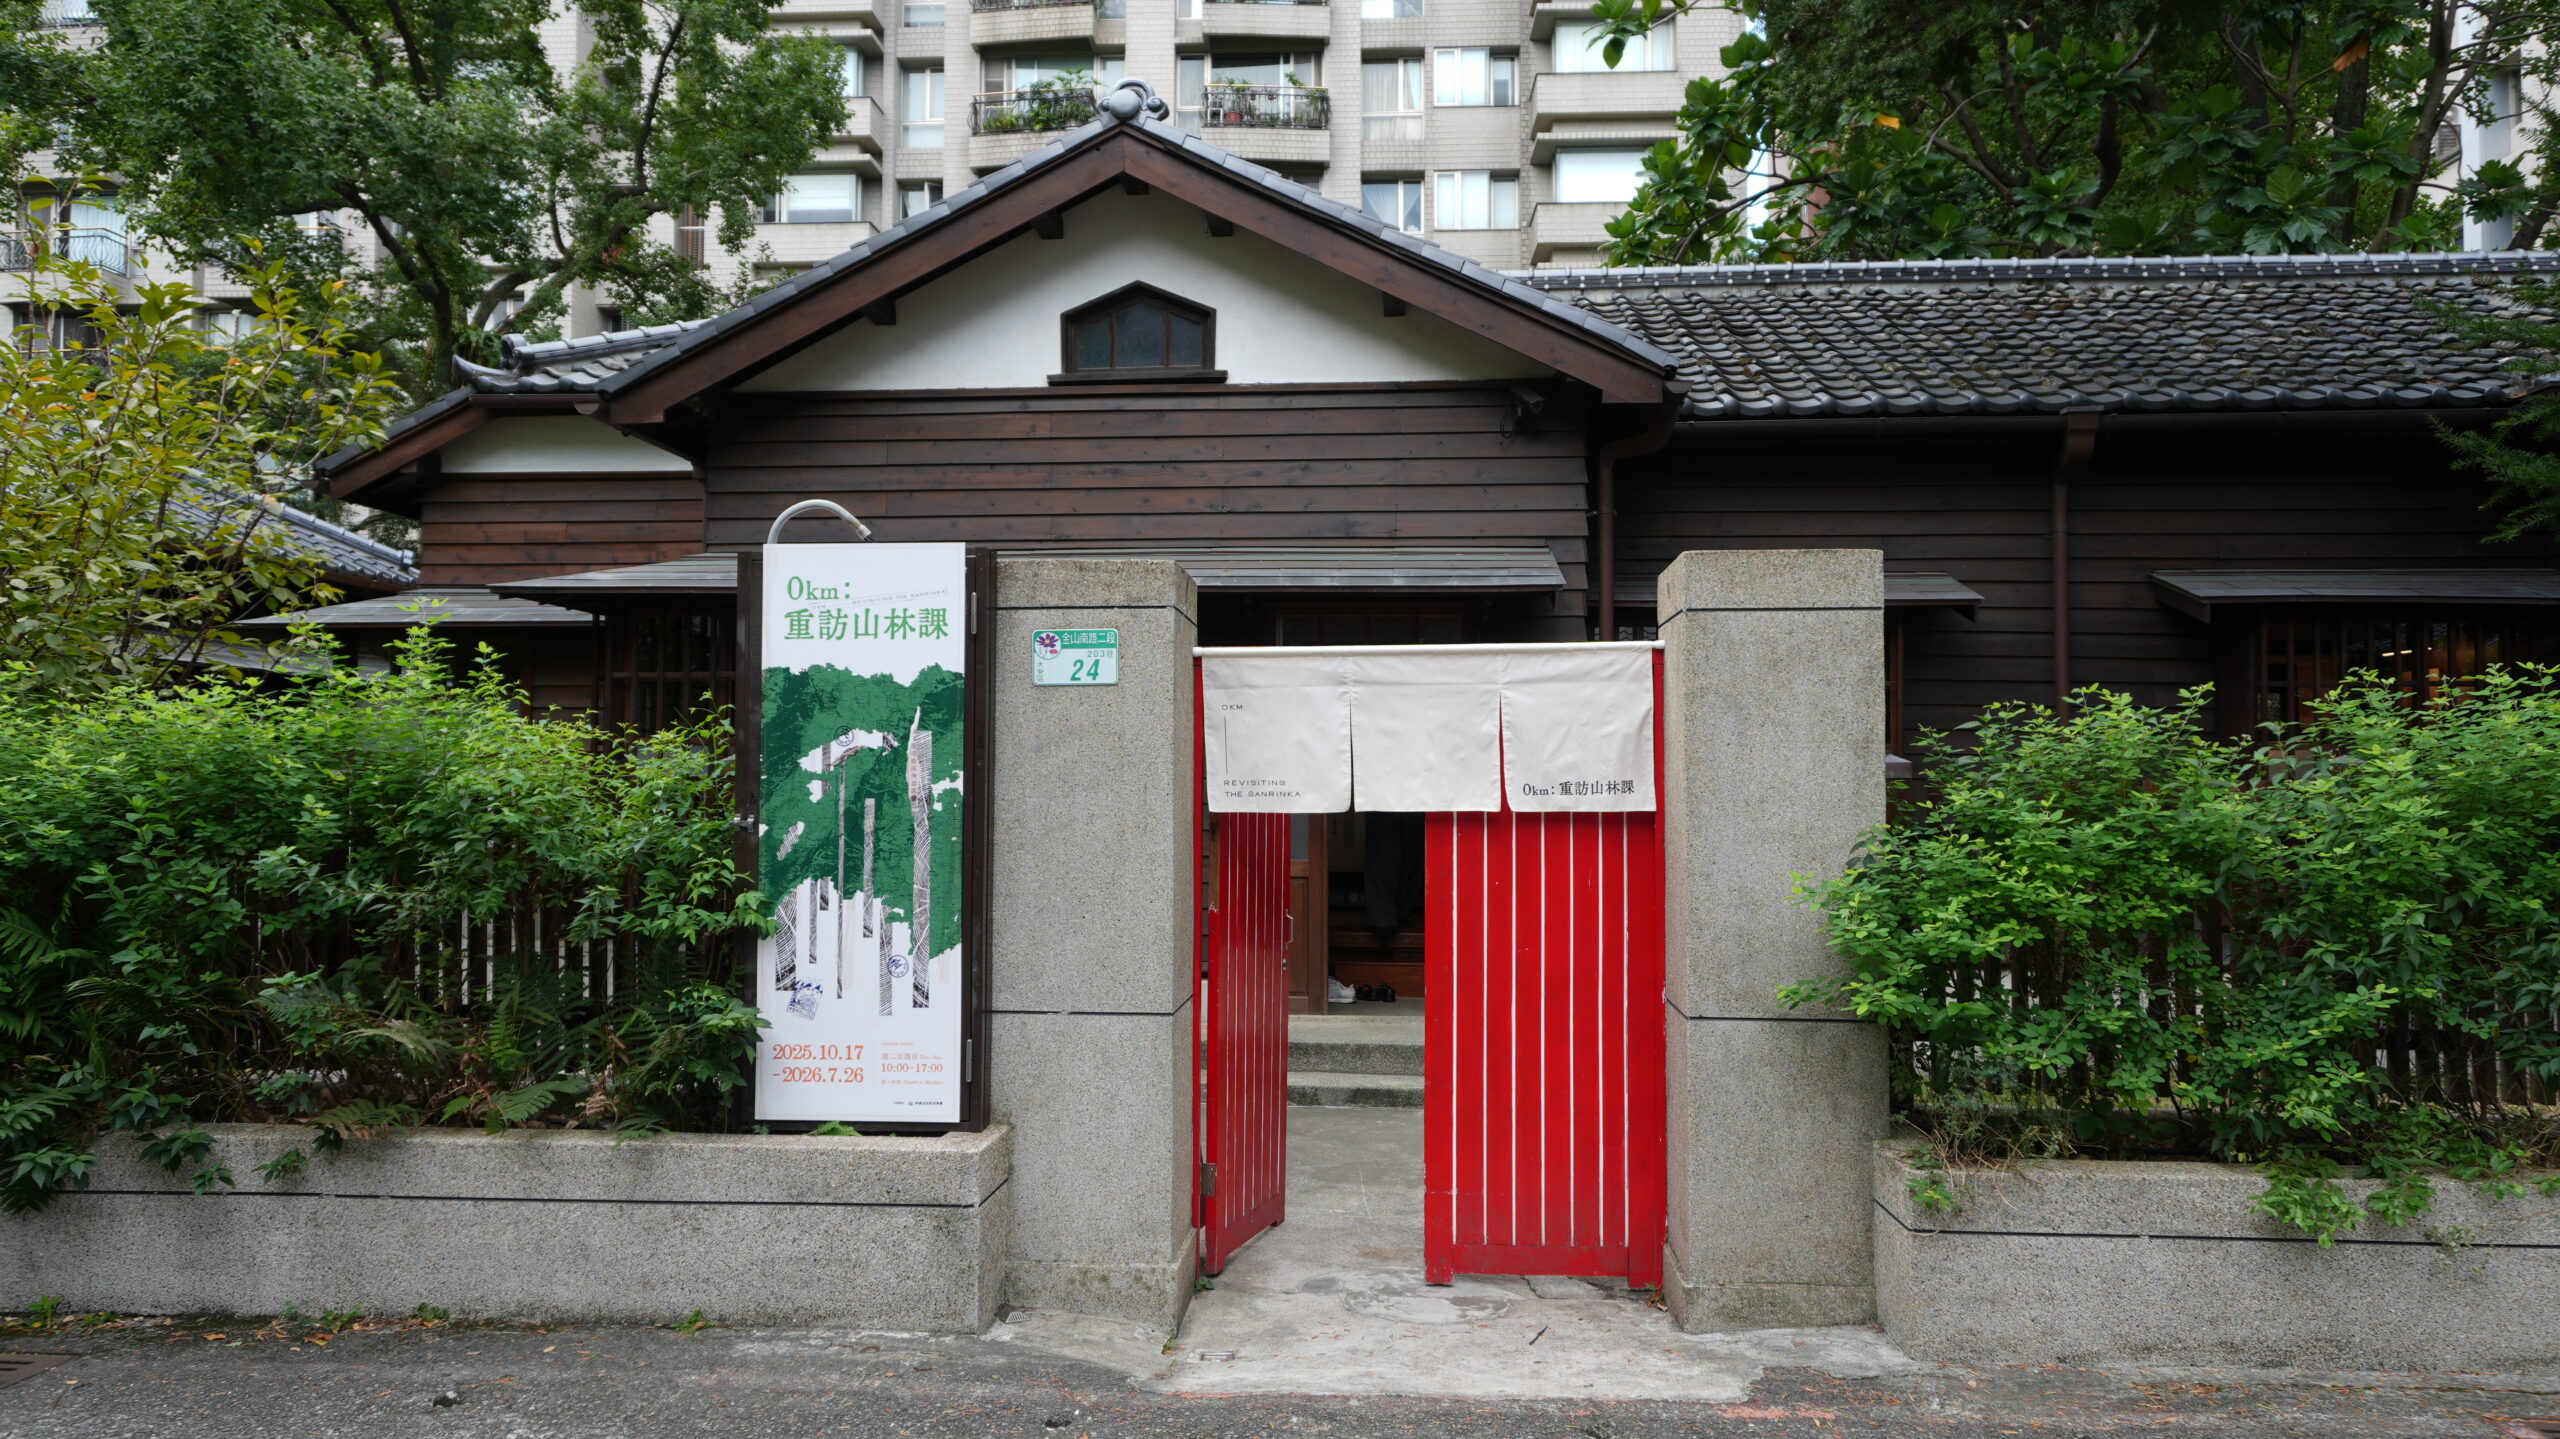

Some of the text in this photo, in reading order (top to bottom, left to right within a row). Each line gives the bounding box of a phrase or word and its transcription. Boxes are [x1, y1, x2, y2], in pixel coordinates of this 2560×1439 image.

[787, 576, 851, 601] 0km:
[784, 608, 949, 640] 重訪山林課
[1061, 631, 1116, 645] 金山南路二段
[1070, 658, 1100, 681] 24
[1559, 780, 1635, 796] 重訪山林課
[772, 1044, 864, 1060] 2025.10.17
